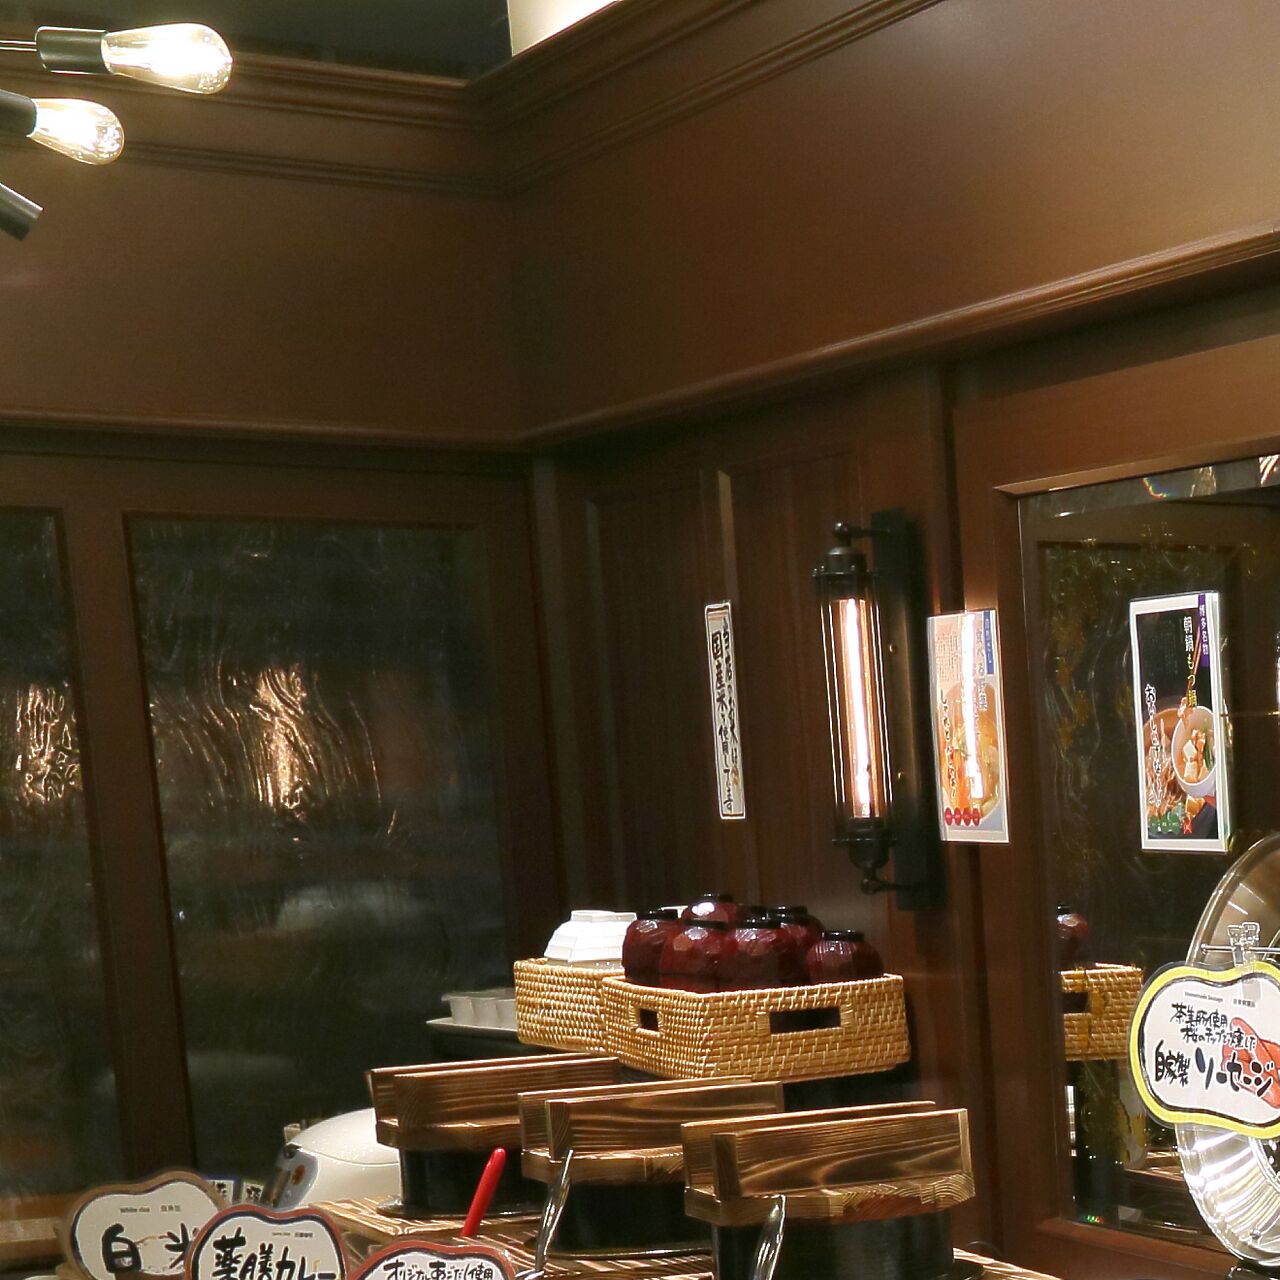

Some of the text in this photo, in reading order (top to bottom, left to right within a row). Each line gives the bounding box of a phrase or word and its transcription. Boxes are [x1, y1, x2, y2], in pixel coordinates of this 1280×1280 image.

[1155, 1040, 1274, 1097] 自家製ソーセージ
